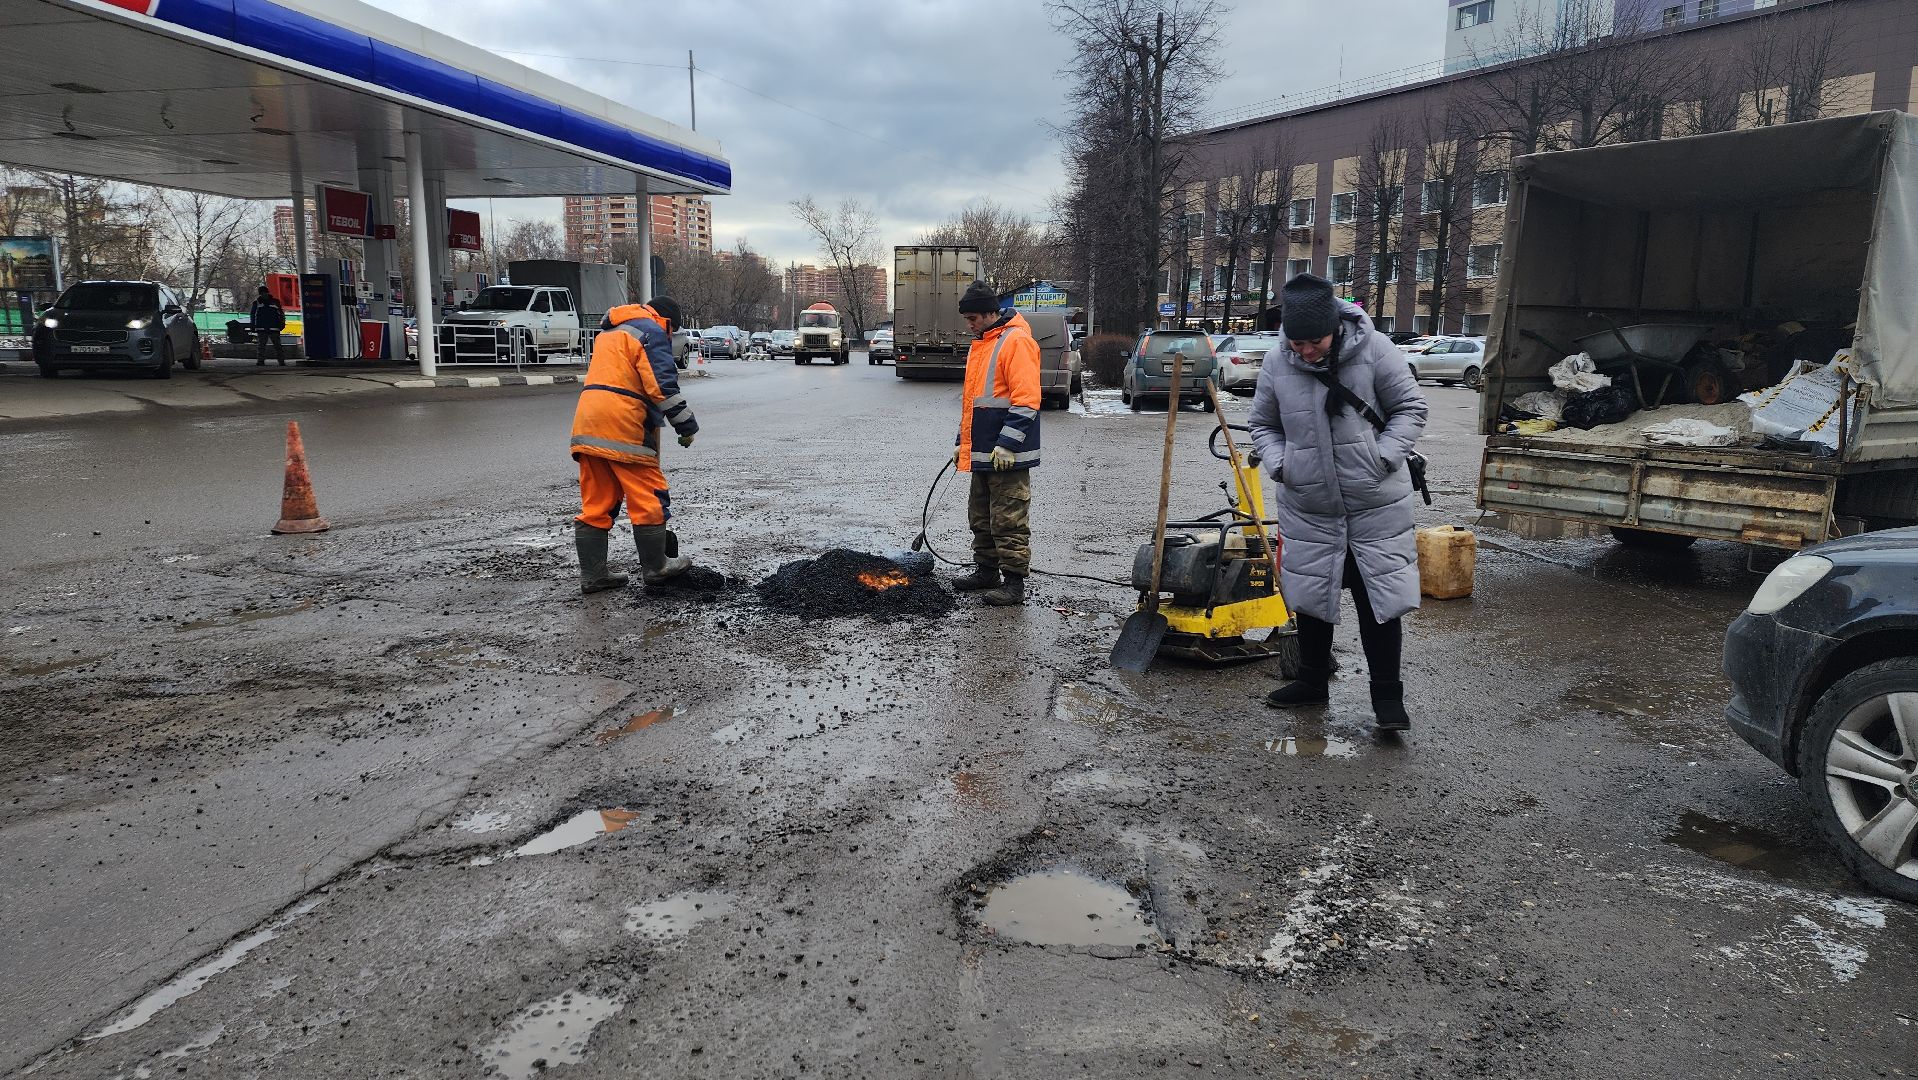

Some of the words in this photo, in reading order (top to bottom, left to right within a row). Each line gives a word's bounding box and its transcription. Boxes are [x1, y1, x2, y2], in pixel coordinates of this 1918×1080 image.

[330, 215, 361, 229] TEBOIL
[382, 228, 388, 237] 3
[369, 341, 375, 352] 3
